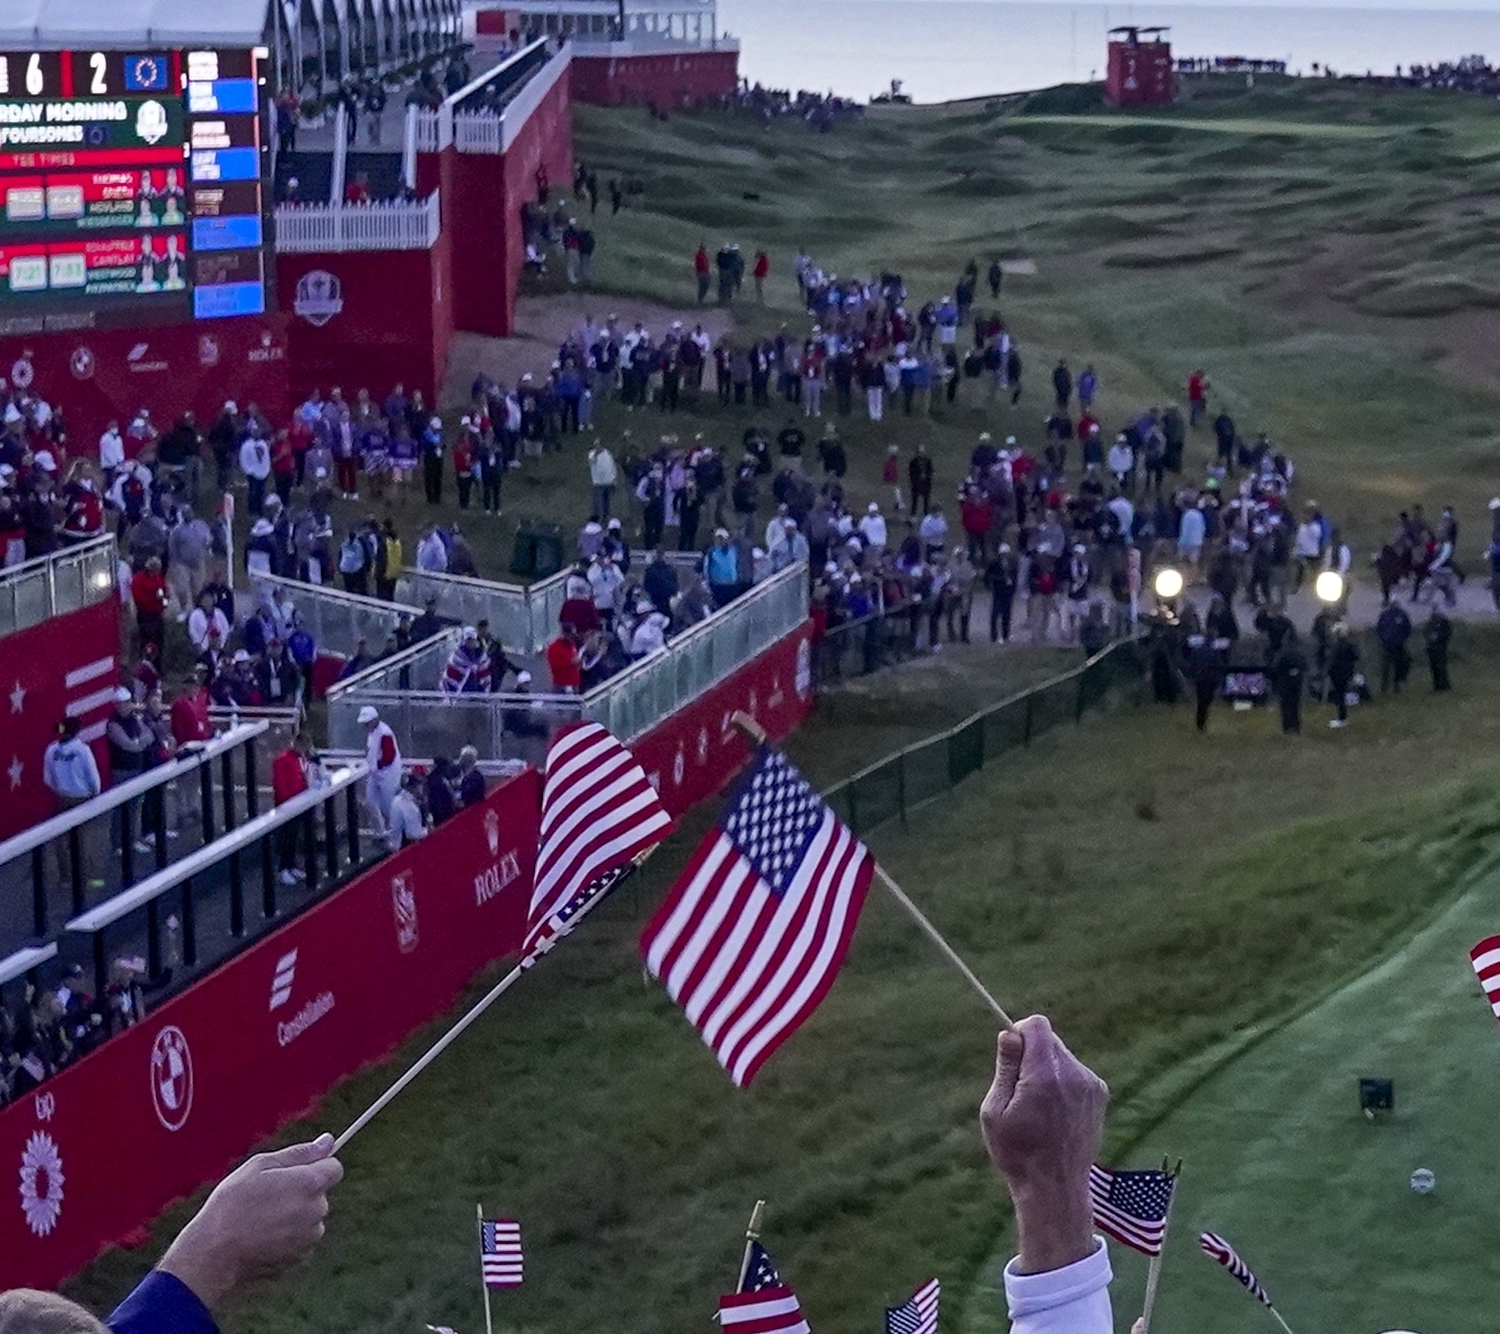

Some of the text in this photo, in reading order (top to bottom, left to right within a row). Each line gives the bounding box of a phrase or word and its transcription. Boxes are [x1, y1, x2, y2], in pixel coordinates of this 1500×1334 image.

[25, 52, 44, 96] 6
[89, 51, 107, 95] 2
[45, 100, 128, 123] MORNING
[0, 124, 84, 145] FOURSOMES
[473, 848, 522, 907] ROLEX
[34, 1091, 56, 1122] bp
